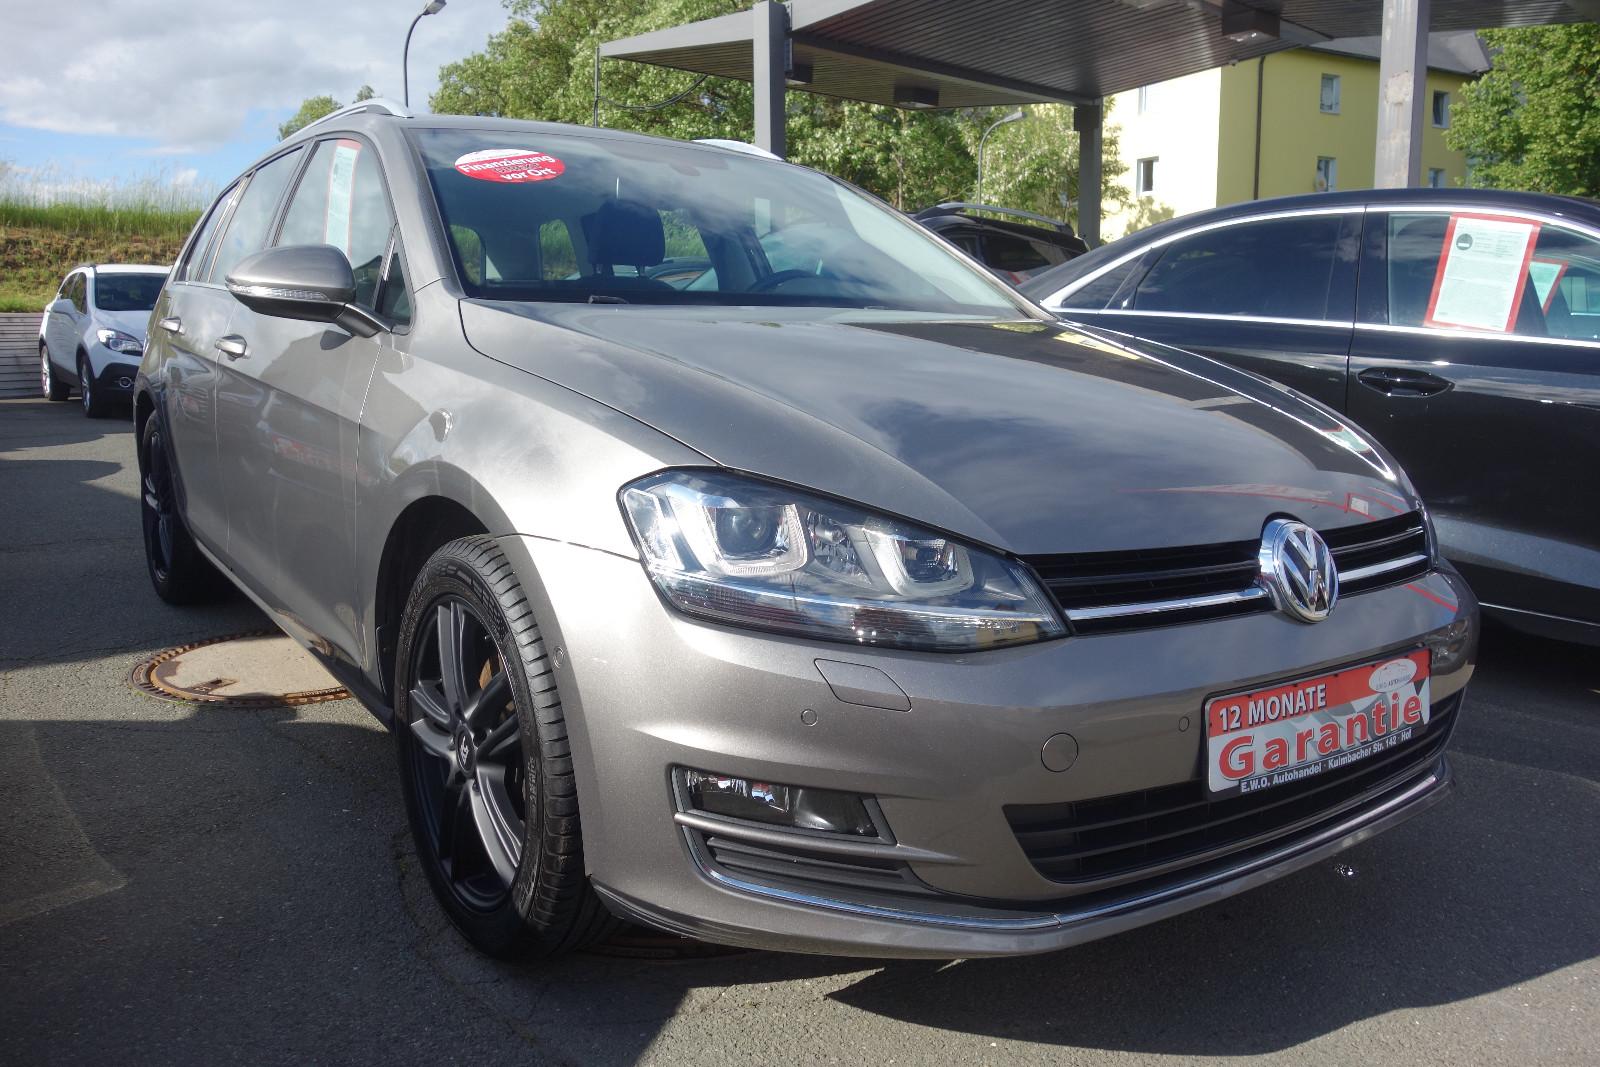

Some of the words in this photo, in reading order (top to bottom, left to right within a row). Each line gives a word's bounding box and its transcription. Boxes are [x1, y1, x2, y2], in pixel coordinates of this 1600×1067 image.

[458, 155, 556, 173] Finanzierung
[501, 170, 529, 180] vor
[528, 167, 557, 177] Ort
[1219, 705, 1241, 731] 12
[1248, 684, 1327, 725] MONATE
[1219, 691, 1423, 780] Garantie
[1241, 774, 1271, 793] E.W.O.
[1273, 763, 1322, 787] Autohandel
[1328, 748, 1372, 769] Kulmbacher
[1372, 742, 1384, 755] Str.
[1386, 736, 1397, 749] 142
[1401, 727, 1412, 739] Hof
